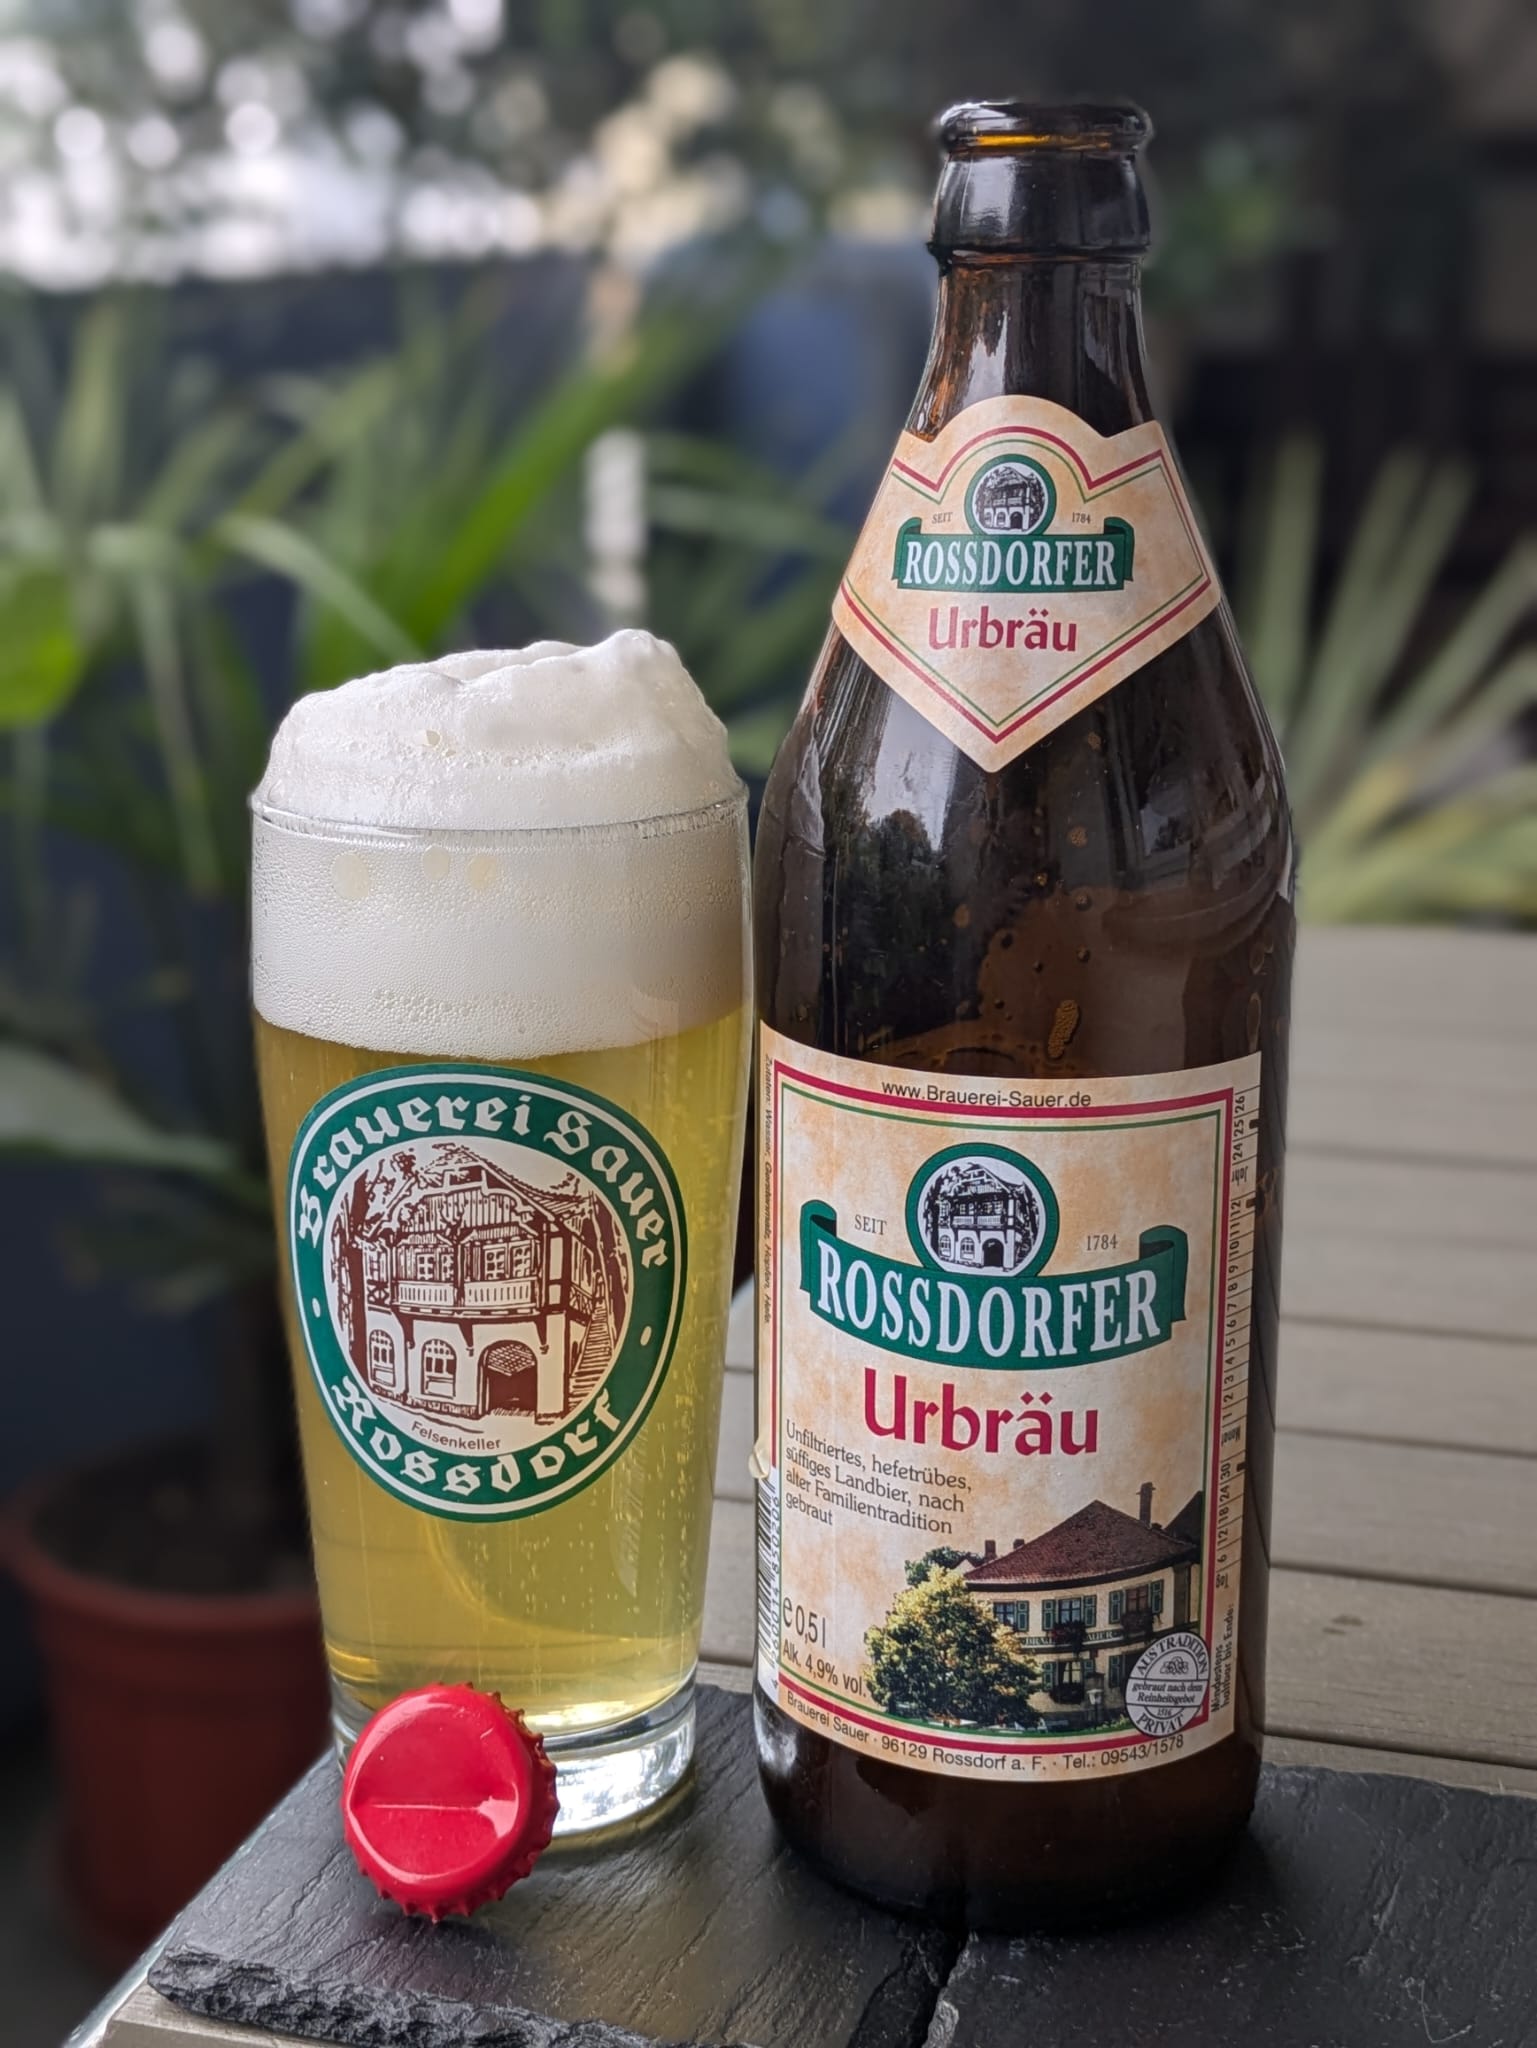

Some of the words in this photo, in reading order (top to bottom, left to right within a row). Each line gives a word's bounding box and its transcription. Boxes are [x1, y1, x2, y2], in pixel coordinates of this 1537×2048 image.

[932, 512, 953, 524] SEIT
[1072, 512, 1091, 525] 1784
[903, 540, 1117, 587] ROSSDORFER
[928, 605, 1077, 652] Urbräu
[882, 1081, 1092, 1107] www.Brauerei-Sauer.de
[1235, 1095, 1245, 1114] 26
[1234, 1119, 1244, 1137] 25
[1233, 1142, 1243, 1160] 24
[298, 1094, 532, 1247] Brauerei
[544, 1110, 668, 1269] Sauer
[1231, 1166, 1248, 1186] Jahr
[1231, 1201, 1241, 1217] 12
[854, 1213, 887, 1236] SEIT
[1086, 1233, 1118, 1252] 1784
[1230, 1222, 1240, 1237] 11
[1229, 1240, 1240, 1256] 10
[1228, 1282, 1238, 1292] 8
[817, 1239, 1161, 1359] ROSSDORFER
[1227, 1303, 1237, 1312] 7
[1225, 1338, 1236, 1347] 5
[1225, 1356, 1235, 1365] 4
[1224, 1374, 1234, 1384] 3
[1223, 1392, 1234, 1402] 2
[864, 1368, 1099, 1455] Urbräu
[1222, 1412, 1233, 1420] 1
[331, 1375, 623, 1495] Rossdorf
[411, 1420, 501, 1450] Felsenkeller
[786, 1418, 866, 1472] Unfiltriertes,
[872, 1454, 972, 1492] hefetrübes,
[785, 1447, 831, 1479] süffiges
[835, 1465, 912, 1507] Landbier,
[918, 1493, 965, 1512] nach
[1220, 1462, 1231, 1480] 30
[785, 1468, 811, 1492] alter
[815, 1480, 953, 1534] Familientradition
[1219, 1485, 1230, 1501] 24
[785, 1492, 833, 1525] gebraut
[1218, 1507, 1229, 1523] 18
[1217, 1528, 1228, 1545] 12
[1136, 1648, 1158, 1675] AUS
[1157, 1634, 1208, 1674] TRADITION
[783, 1639, 801, 1668] Alk.
[805, 1653, 838, 1686] 4,9%
[843, 1672, 867, 1698] vol.
[1132, 1683, 1166, 1692] gebraut
[1167, 1683, 1186, 1692] nach
[787, 1690, 829, 1727] Brauerei
[833, 1715, 869, 1744] Sauer
[881, 1735, 928, 1759] 96129
[932, 1747, 1007, 1769] Rossdorf
[1011, 1758, 1025, 1770] a.
[1032, 1756, 1047, 1770] F.
[1062, 1755, 1096, 1769] Tel.:
[1100, 1734, 1184, 1766] 09543/1578
[1136, 1712, 1184, 1733] PRIVAT
